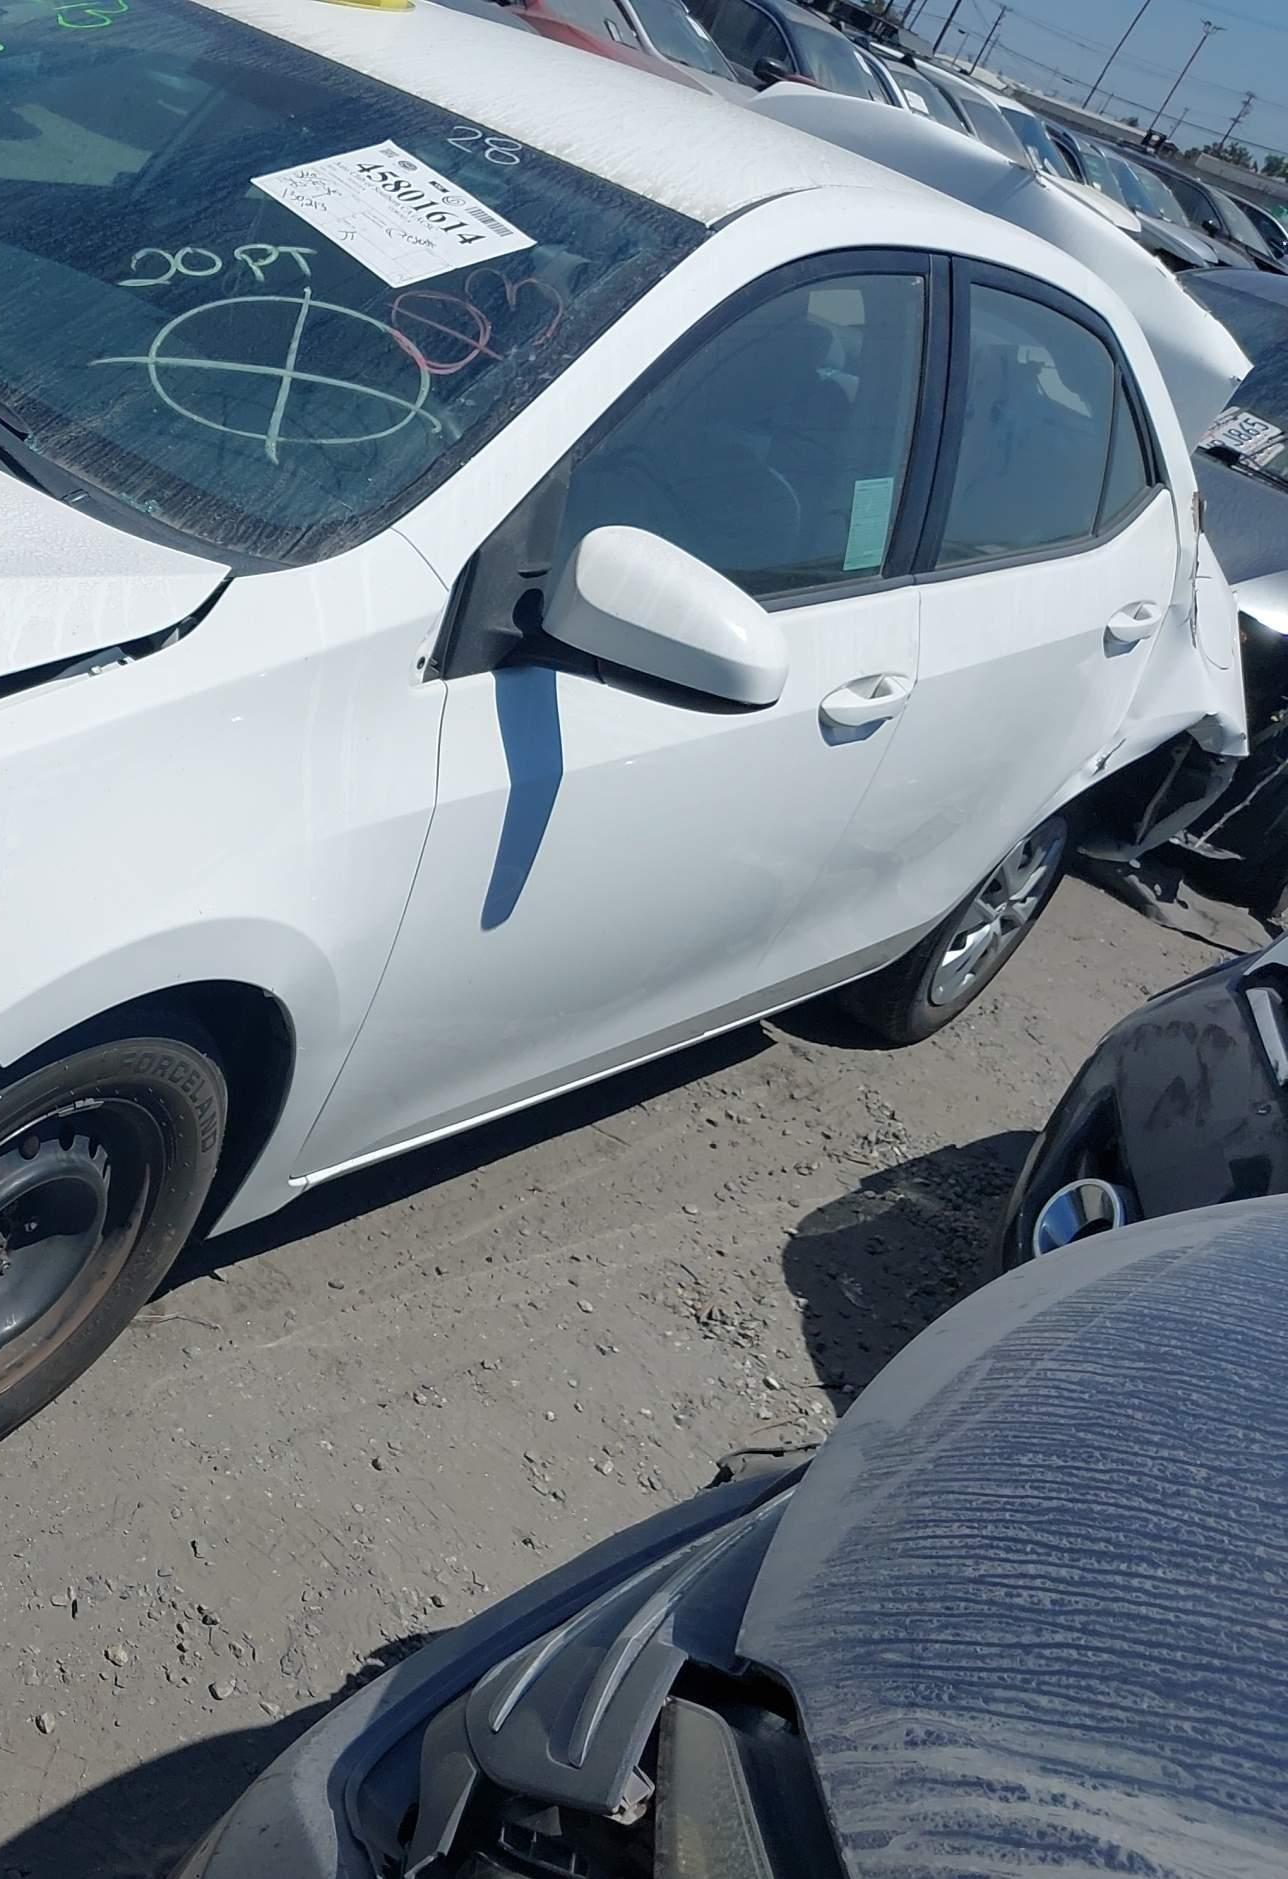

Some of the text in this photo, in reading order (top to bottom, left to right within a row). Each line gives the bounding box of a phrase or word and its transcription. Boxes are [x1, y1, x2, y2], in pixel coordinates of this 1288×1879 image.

[355, 162, 487, 246] 45801614
[119, 246, 223, 287] 20
[121, 1050, 219, 1154] FORCELAND
